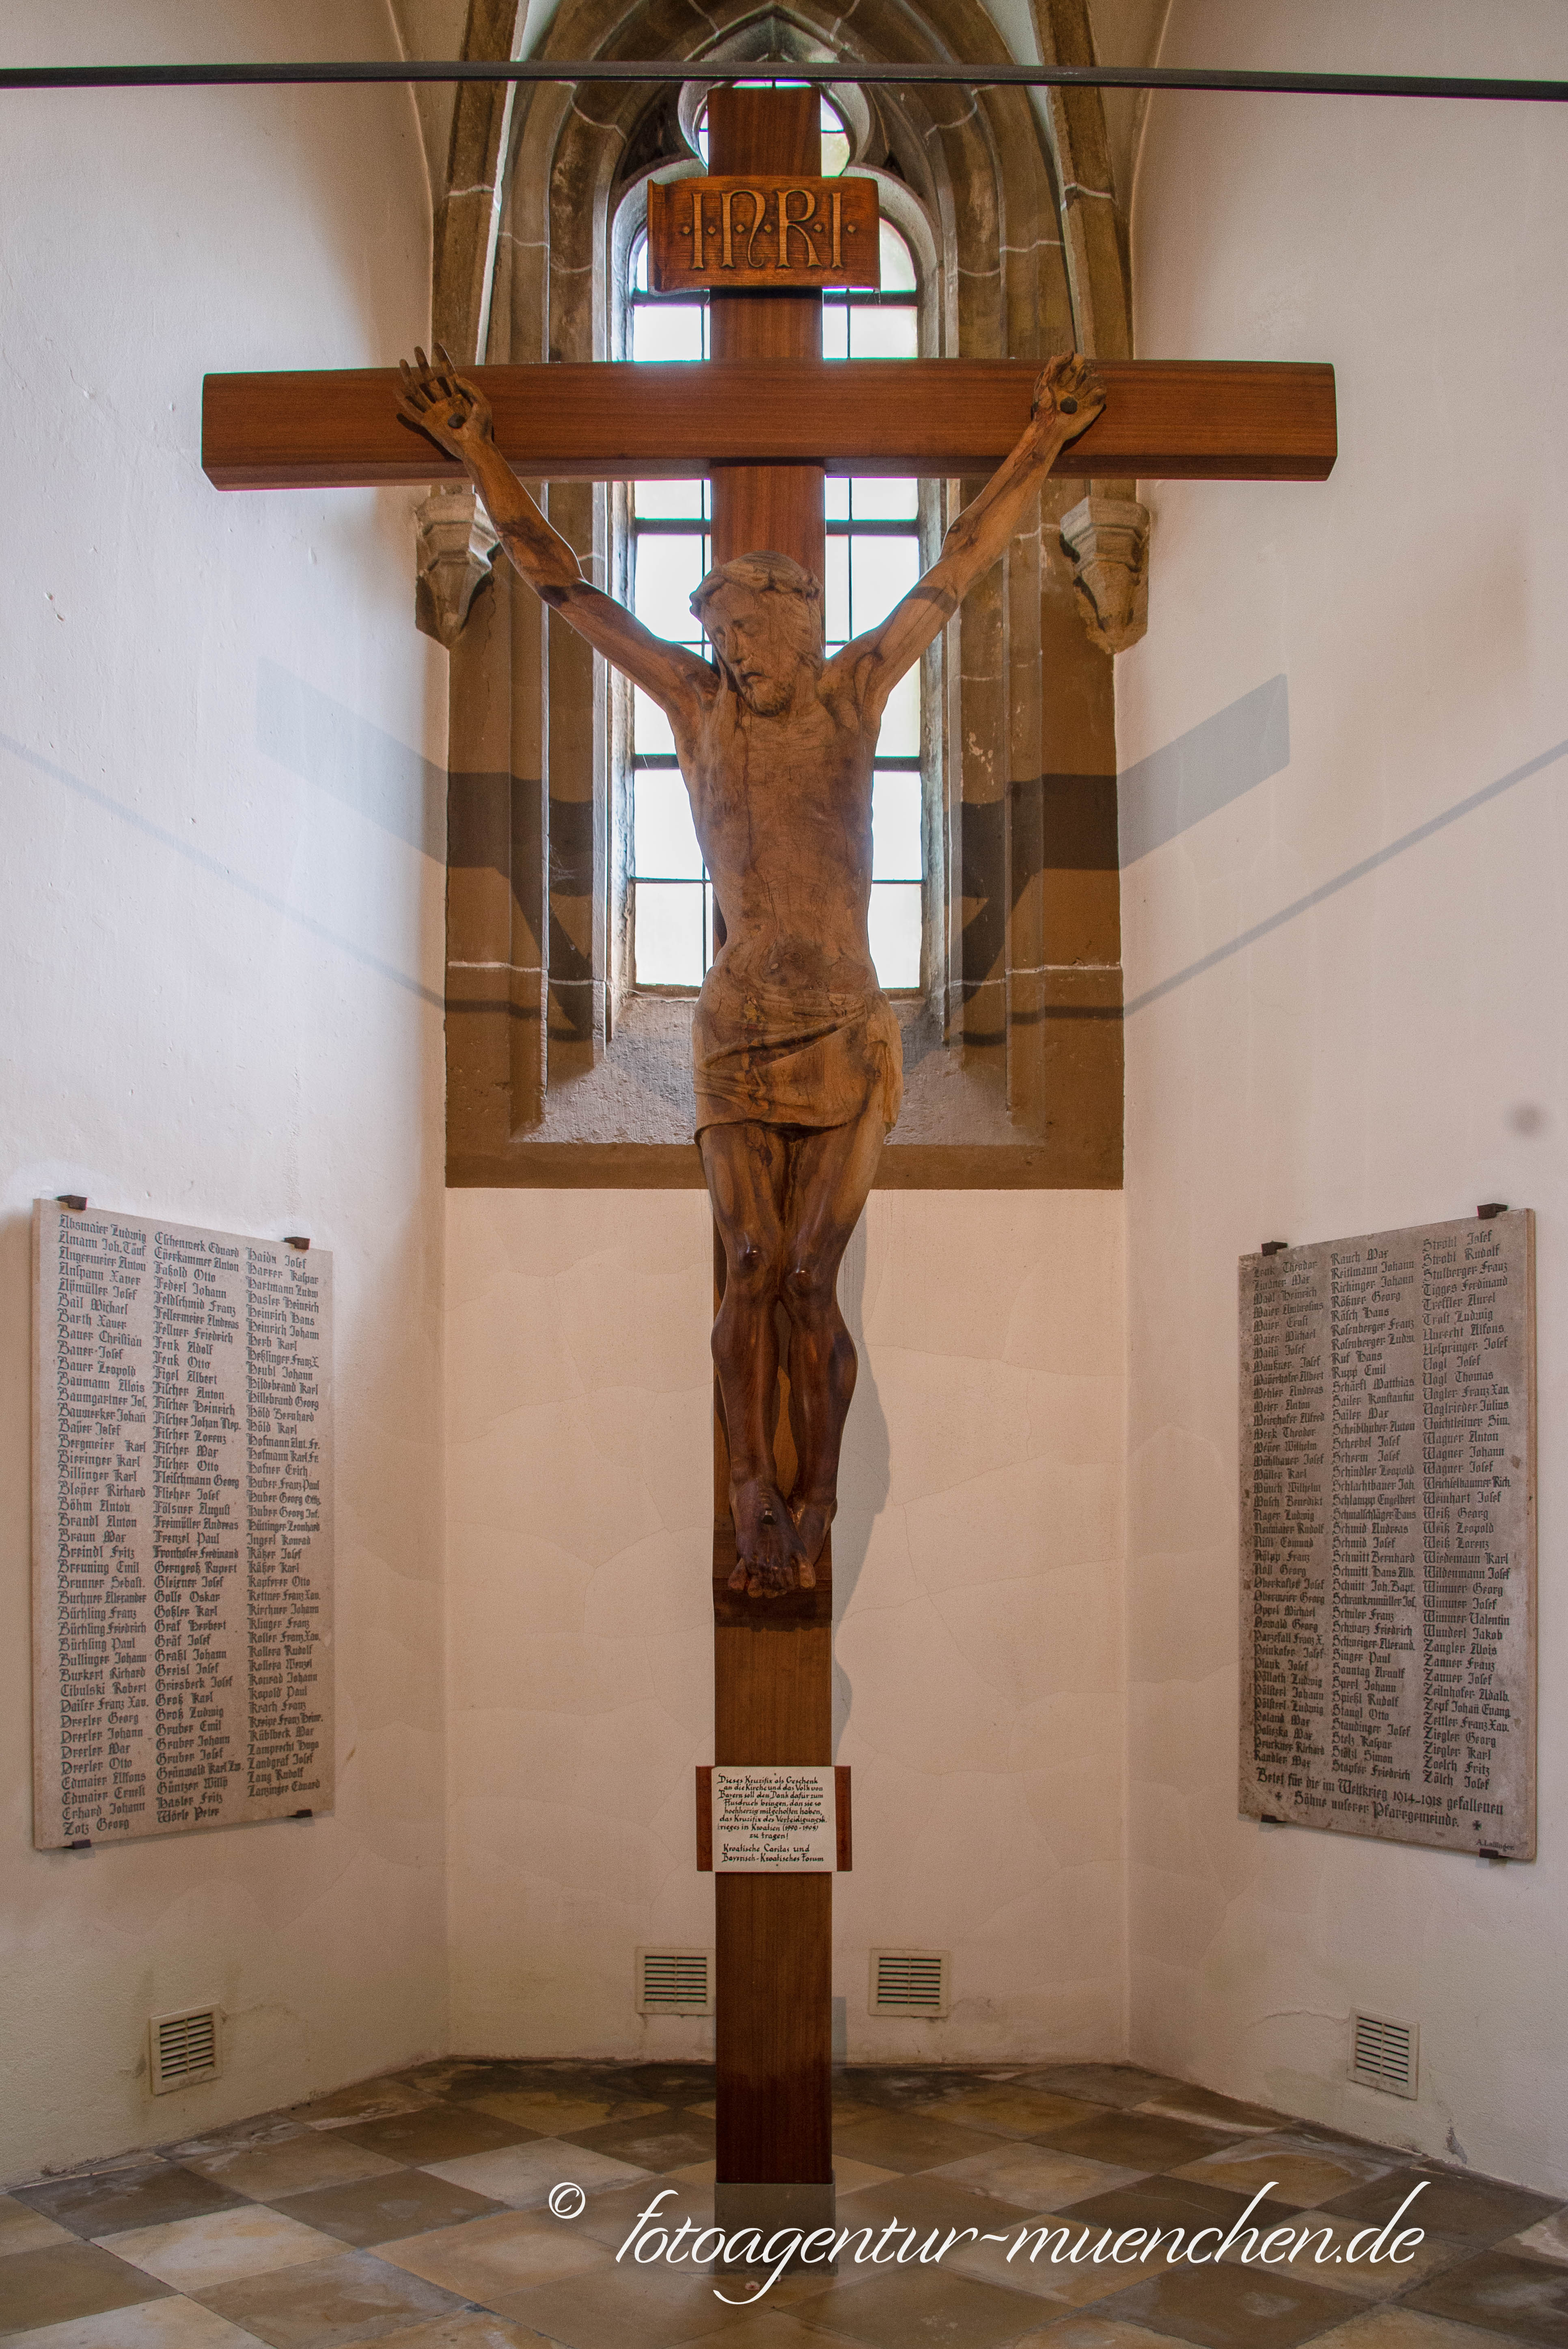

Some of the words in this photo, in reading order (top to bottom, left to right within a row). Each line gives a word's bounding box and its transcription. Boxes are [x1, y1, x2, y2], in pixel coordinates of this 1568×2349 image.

[58, 1214, 108, 1235] Absmaier
[110, 1223, 147, 1245] Ludwig
[58, 1246, 116, 1267] Angermeier
[118, 1255, 146, 1272] Anton
[153, 1275, 187, 1293] Federl
[192, 1281, 226, 1299] Johann
[57, 1292, 83, 1309] Bail
[90, 1297, 129, 1315] Michael
[245, 1289, 280, 1306] Hasler
[282, 1296, 319, 1314] Heinrich
[56, 1307, 92, 1326] Barth
[245, 1303, 287, 1322] Heinrich
[290, 1311, 315, 1326] Hans
[152, 1320, 189, 1337] Fellner
[193, 1327, 233, 1344] Friedrich
[152, 1335, 180, 1352] Fenk
[187, 1340, 214, 1355] Adolf
[276, 1337, 297, 1351] Karl
[56, 1355, 93, 1372] Bauer
[97, 1360, 136, 1377] Leopold
[282, 1365, 313, 1381] Johann
[56, 1370, 110, 1389] Baumann
[118, 1378, 145, 1393] Alois
[152, 1364, 179, 1381] Figel
[186, 1369, 217, 1385] Albert
[58, 1433, 115, 1450] Bergmeier
[124, 1439, 147, 1453] Karl
[57, 1463, 109, 1481] Billinger
[112, 1469, 137, 1482] Karl
[57, 1496, 92, 1511] Böhm
[99, 1499, 130, 1512] Anton
[57, 1511, 99, 1527] Brandl
[106, 1514, 137, 1528] Anton
[196, 1531, 220, 1544] Paul
[56, 1558, 109, 1573] Breuning
[116, 1560, 139, 1573] Emil
[189, 1590, 220, 1602] Oskar
[154, 1619, 181, 1632] Graf
[187, 1619, 226, 1631] Herbert
[111, 1637, 135, 1649] Paul
[112, 1681, 147, 1694] Robert
[717, 1773, 743, 1784] Dieses
[745, 1775, 772, 1785] Kruzifix
[717, 1789, 742, 1799] Bayern
[770, 1790, 789, 1799] Dank
[790, 1791, 809, 1800] dafür
[109, 1801, 145, 1815] Johann
[725, 1806, 759, 1815] hochherzig
[760, 1807, 798, 1816] mitgeholfen
[800, 1807, 822, 1816] haben,
[761, 1799, 788, 1808] bringen,
[96, 1817, 129, 1831] Georg
[734, 1814, 761, 1823] Kruzifix
[761, 1832, 788, 1840] tragen!
[723, 1843, 760, 1852] Kroatische
[764, 1843, 789, 1852] Caritas
[794, 1844, 809, 1852] und
[802, 1853, 824, 1862] Forum
